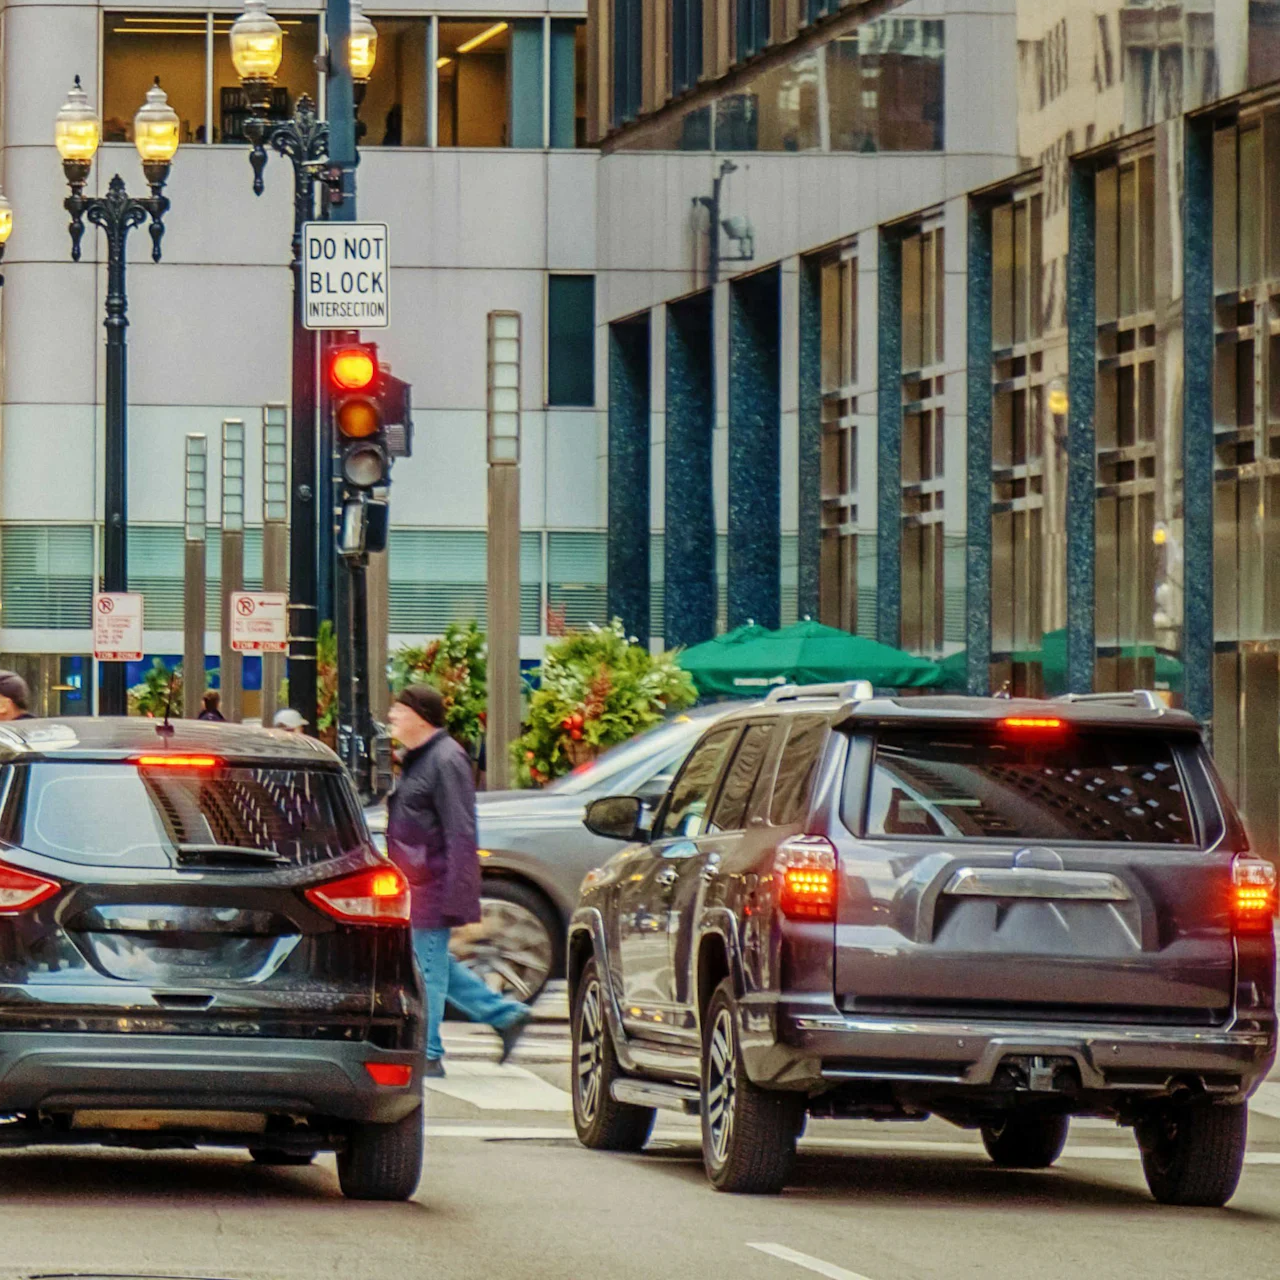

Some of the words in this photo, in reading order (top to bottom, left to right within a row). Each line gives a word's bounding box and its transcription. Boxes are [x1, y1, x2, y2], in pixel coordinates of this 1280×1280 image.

[310, 237, 337, 260] DO
[344, 237, 384, 260] NOT
[310, 271, 384, 294] BLOCK
[309, 302, 385, 317] INTERSECTION
